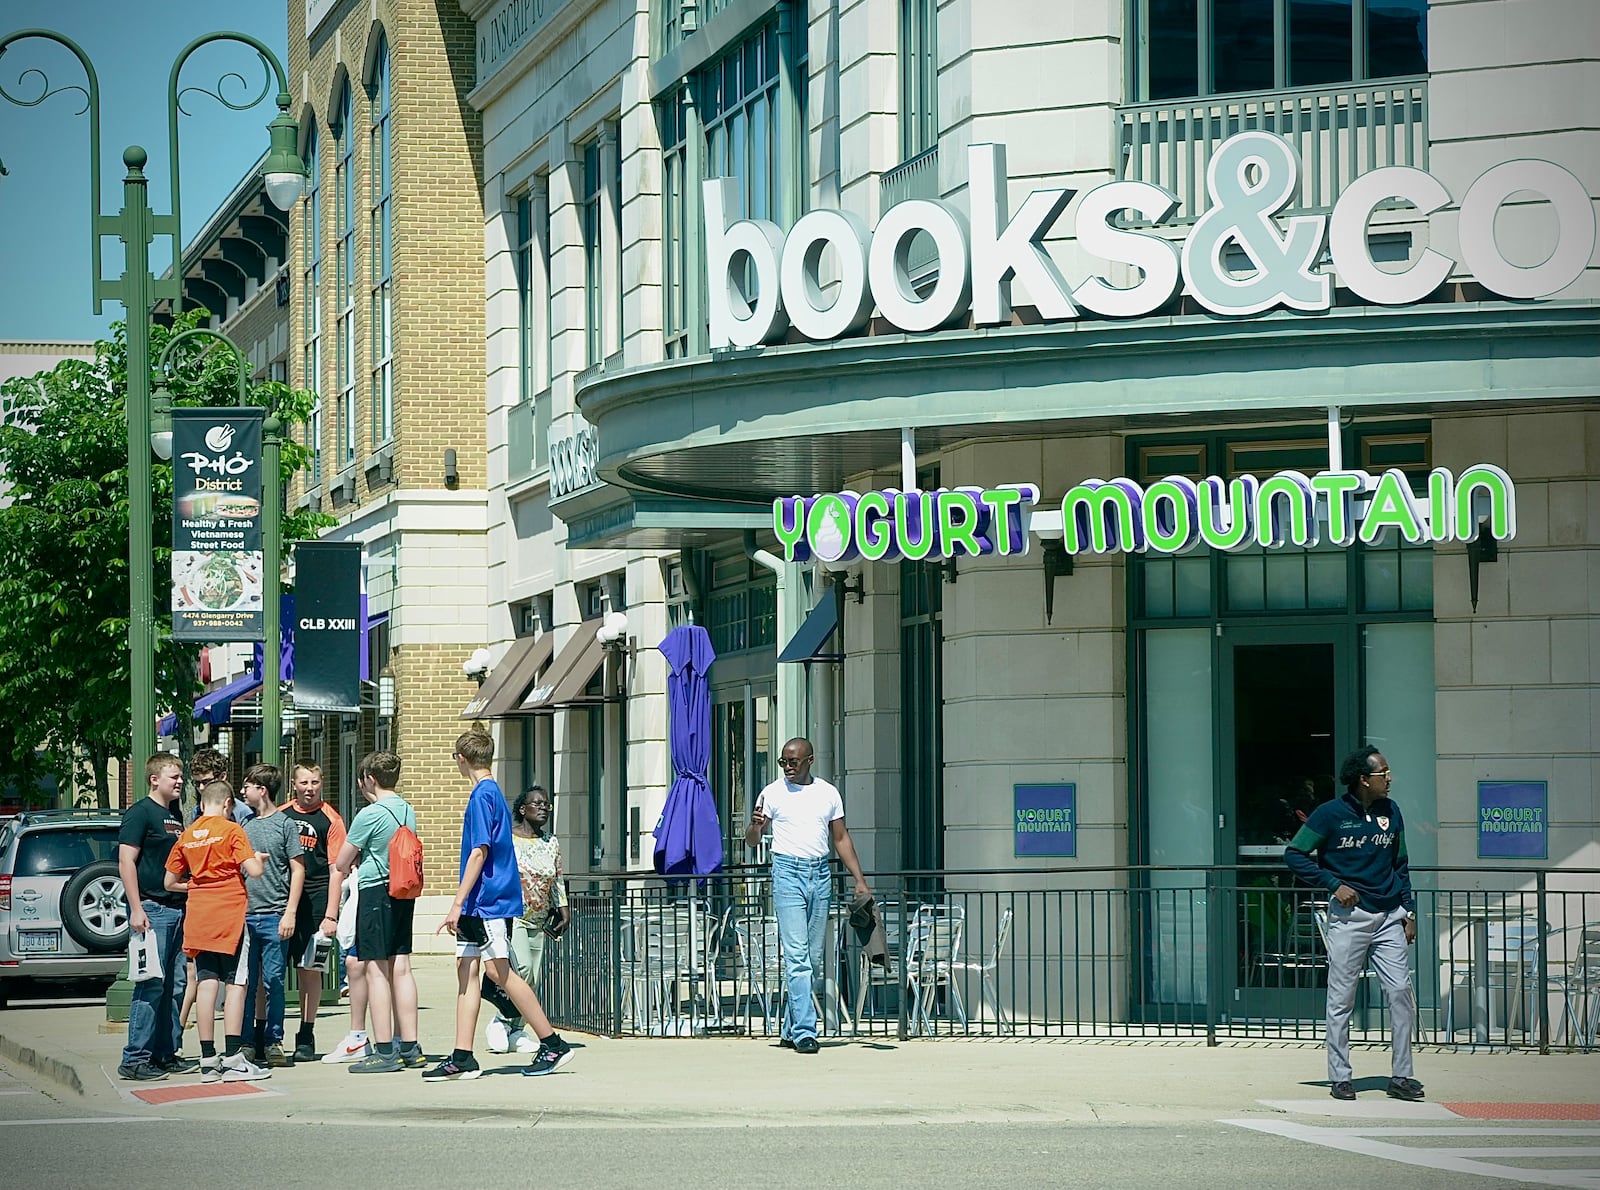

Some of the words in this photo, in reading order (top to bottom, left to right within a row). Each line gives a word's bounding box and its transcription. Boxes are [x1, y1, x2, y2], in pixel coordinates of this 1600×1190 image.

[702, 131, 1596, 350] books&co
[195, 477, 243, 491] District
[773, 484, 1036, 562] YOGURT
[1061, 464, 1515, 555] MOUNTAIN
[182, 520, 217, 529] Healthy
[219, 520, 226, 528] &
[228, 520, 253, 528] Fresh
[191, 530, 244, 539] Vietnamese
[191, 541, 218, 549] Street
[222, 541, 244, 549] Food
[300, 618, 326, 630] CLB
[328, 618, 356, 630] XXIII
[1016, 808, 1071, 822] YOGURT
[1481, 807, 1542, 822] YOGURT
[1017, 821, 1071, 832] MOUNTAIN
[1481, 820, 1542, 832] MOUNTAIN
